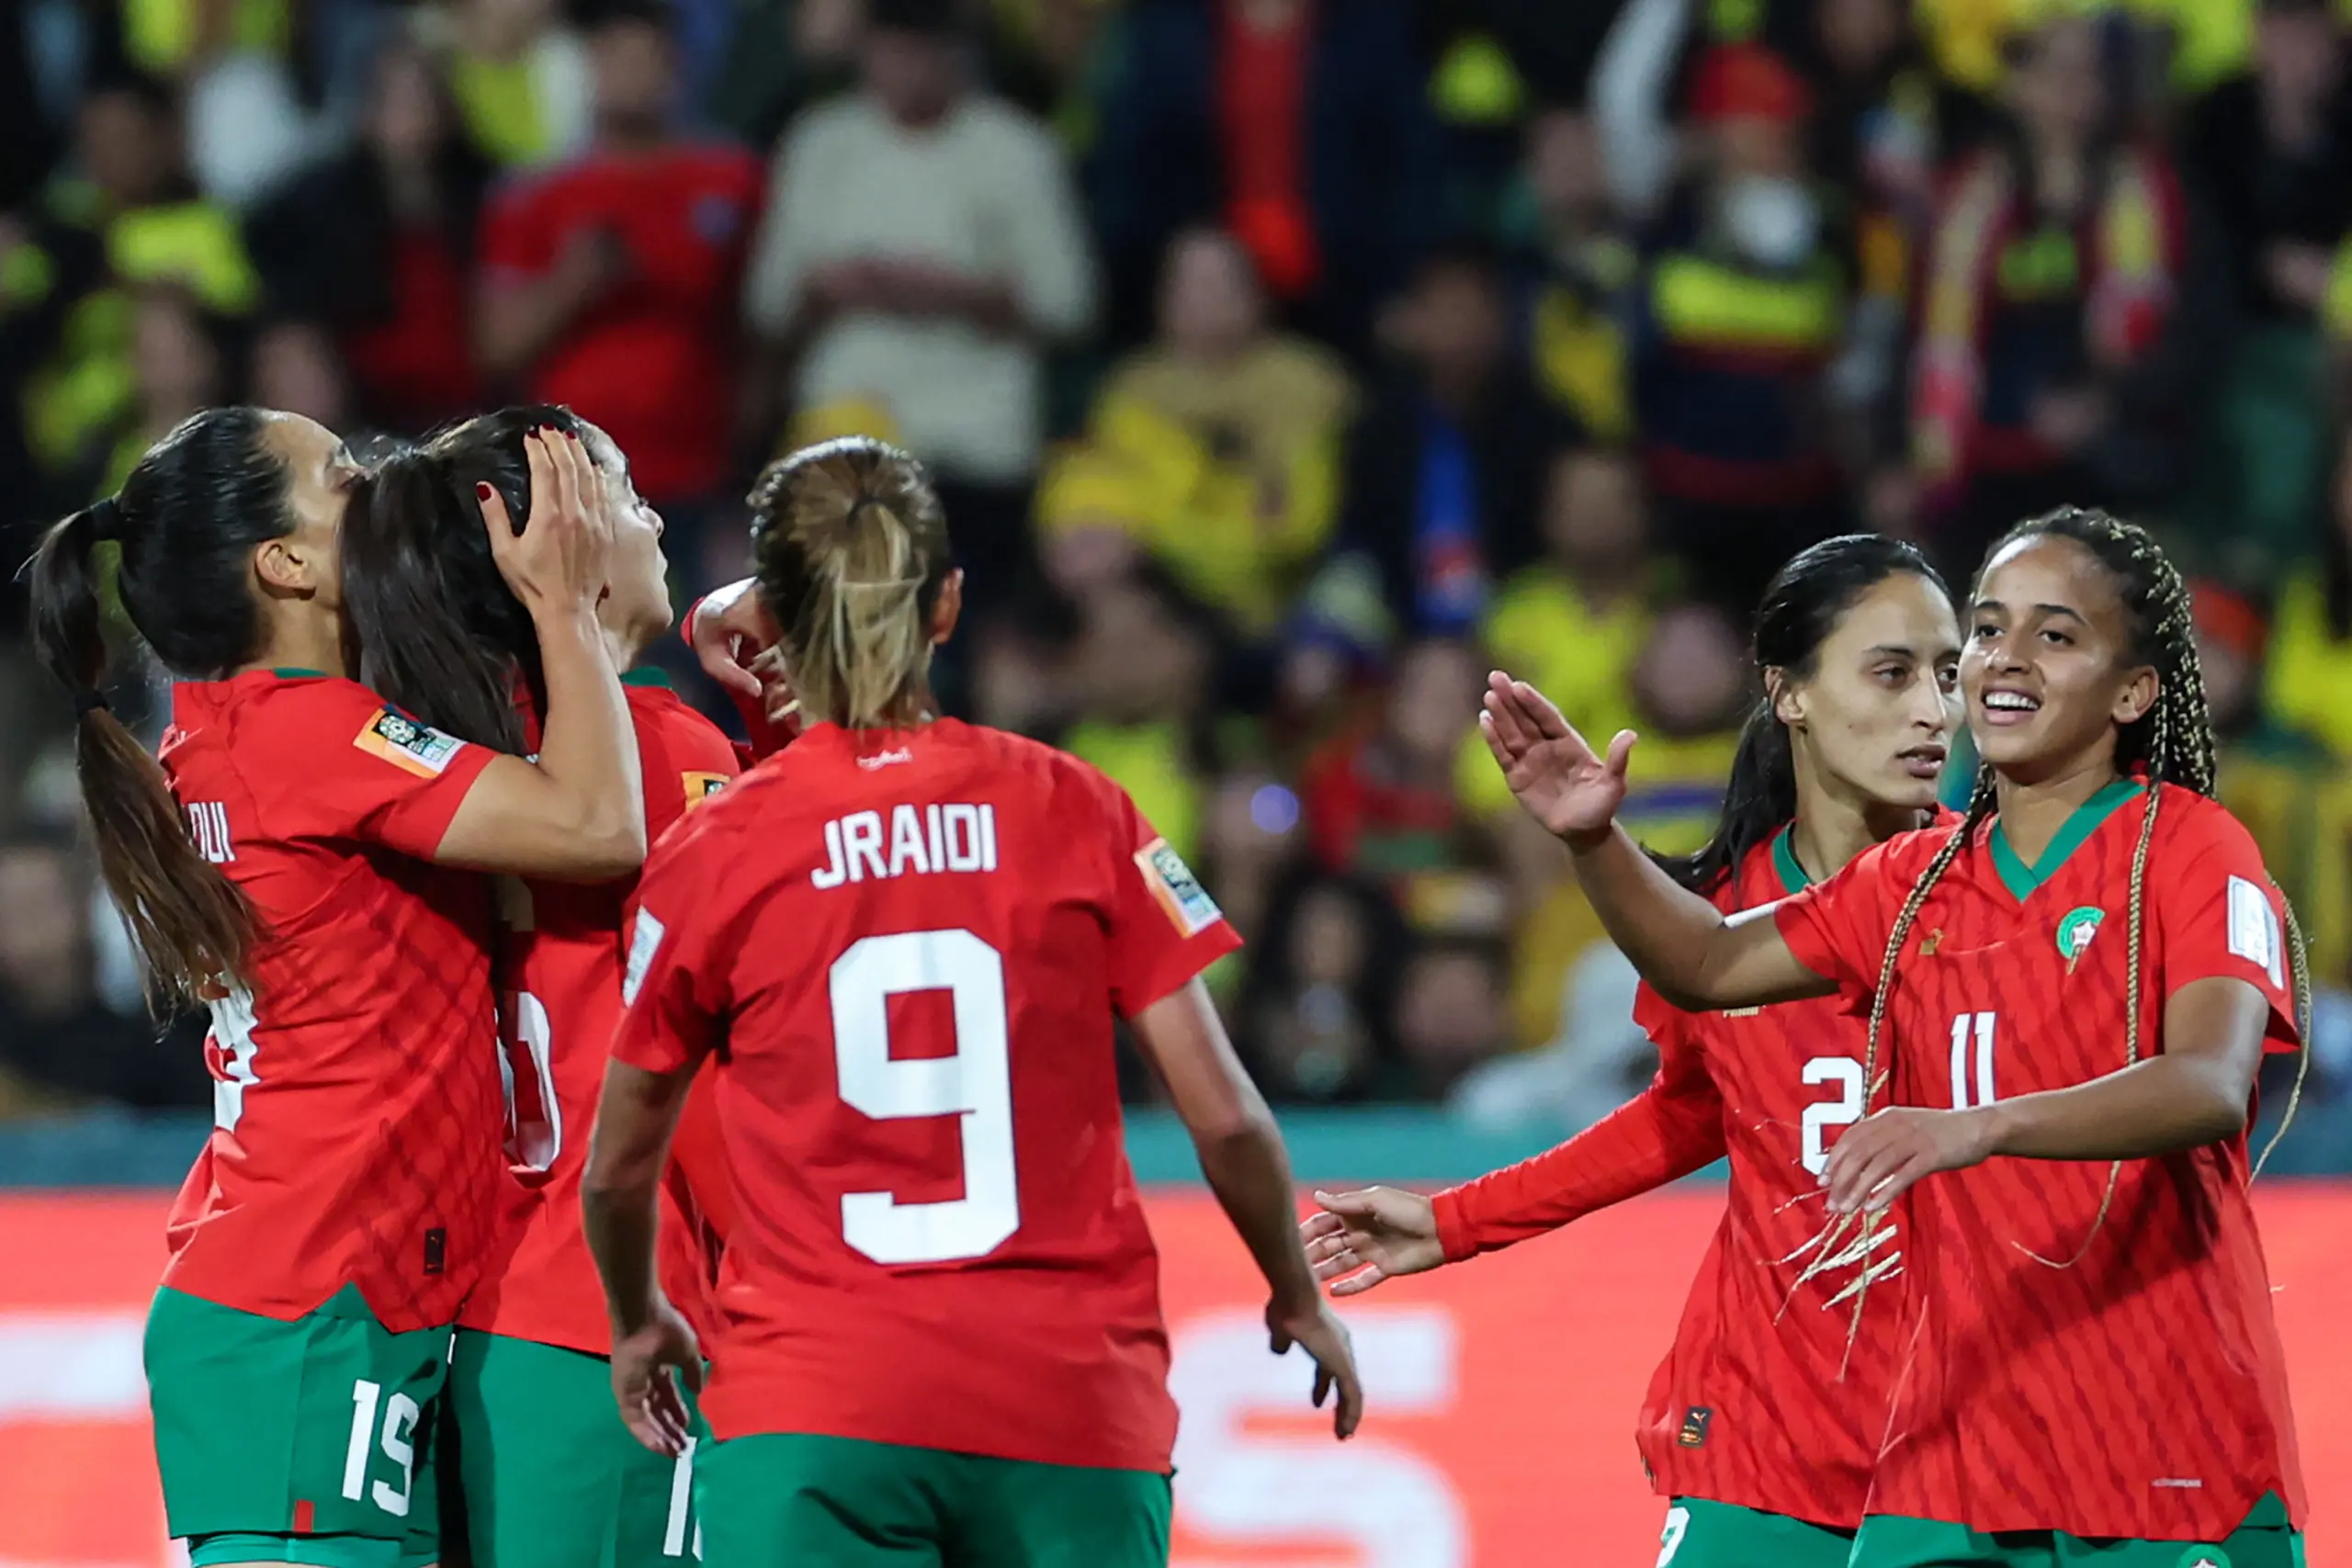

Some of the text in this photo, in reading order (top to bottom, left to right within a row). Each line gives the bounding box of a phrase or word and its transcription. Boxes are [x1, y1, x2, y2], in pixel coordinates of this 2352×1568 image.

[810, 804, 998, 881] JRAIDI
[830, 929, 1020, 1265] 9
[1802, 1056, 1864, 1177] 2
[1951, 1011, 1996, 1111] 11
[342, 1379, 420, 1517] 19
